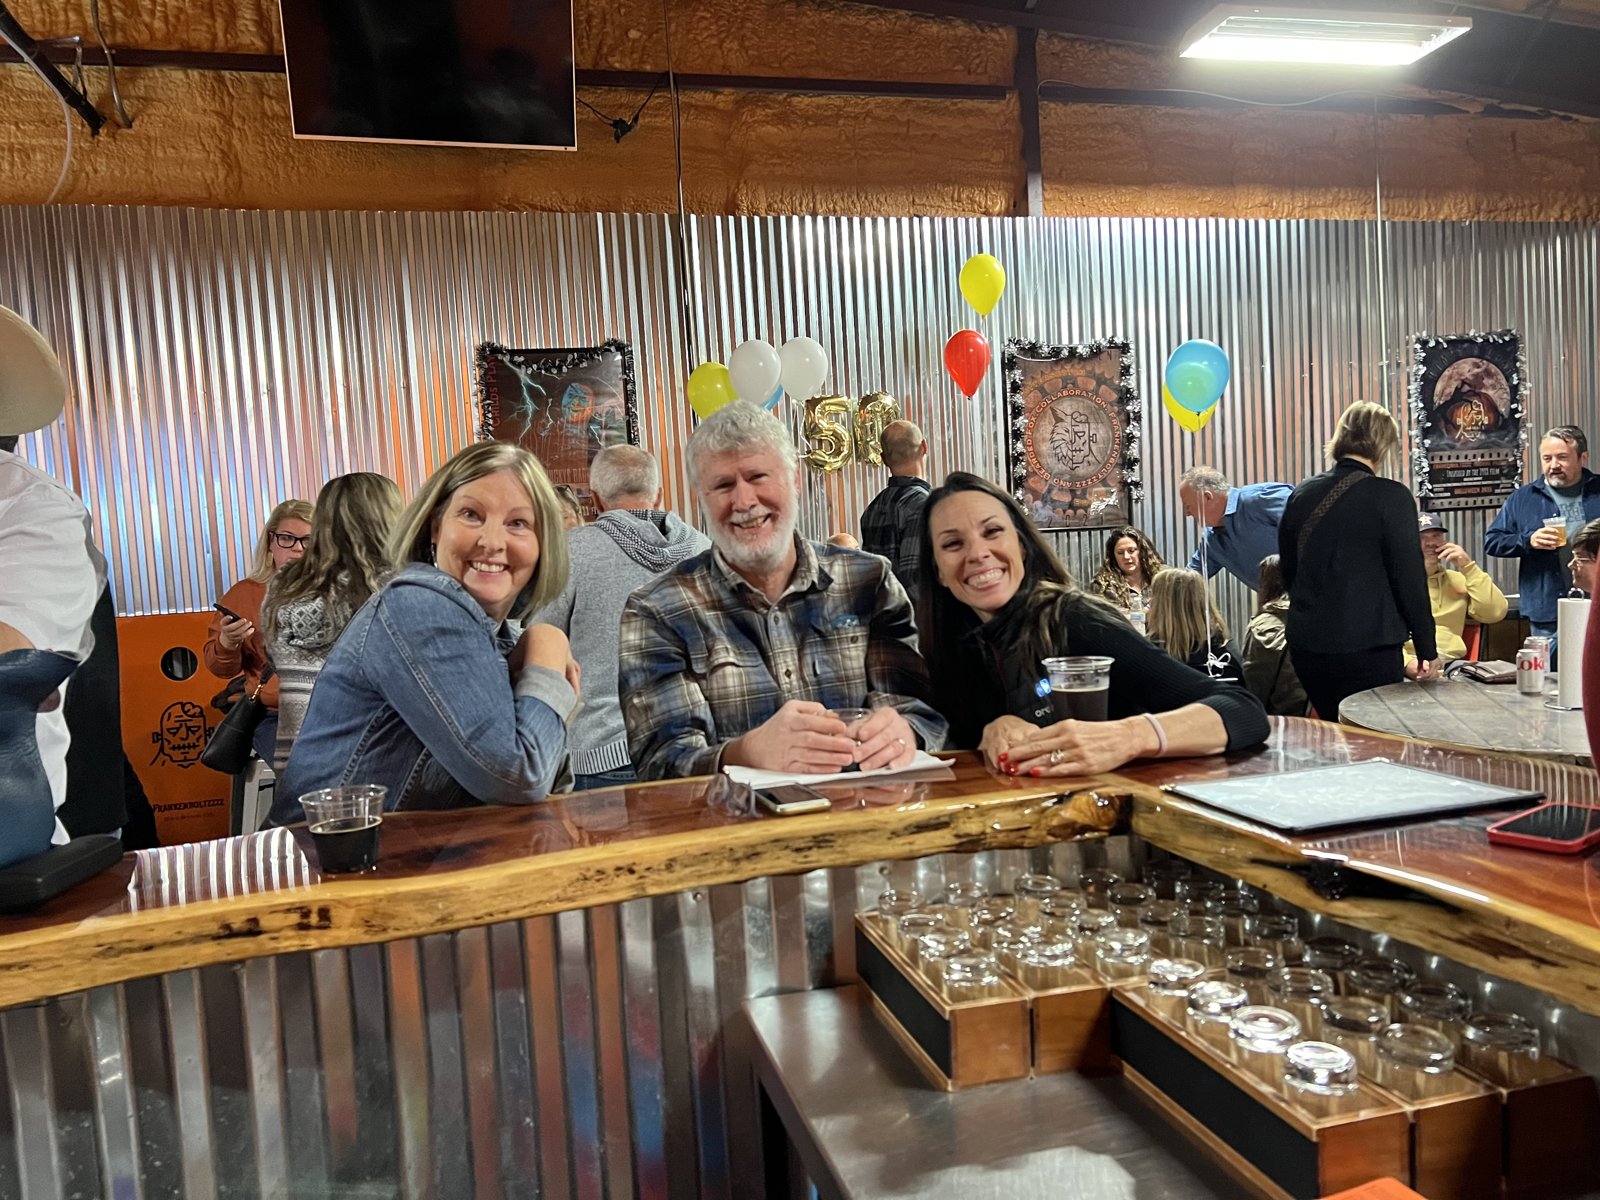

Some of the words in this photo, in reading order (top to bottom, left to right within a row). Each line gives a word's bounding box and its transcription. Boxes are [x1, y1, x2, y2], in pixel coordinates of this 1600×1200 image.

[1026, 439, 1051, 480] BEARDED
[1076, 412, 1121, 488] FRANKENBOLTZZZZ
[1053, 478, 1072, 488] AND
[1520, 656, 1545, 671] ok
